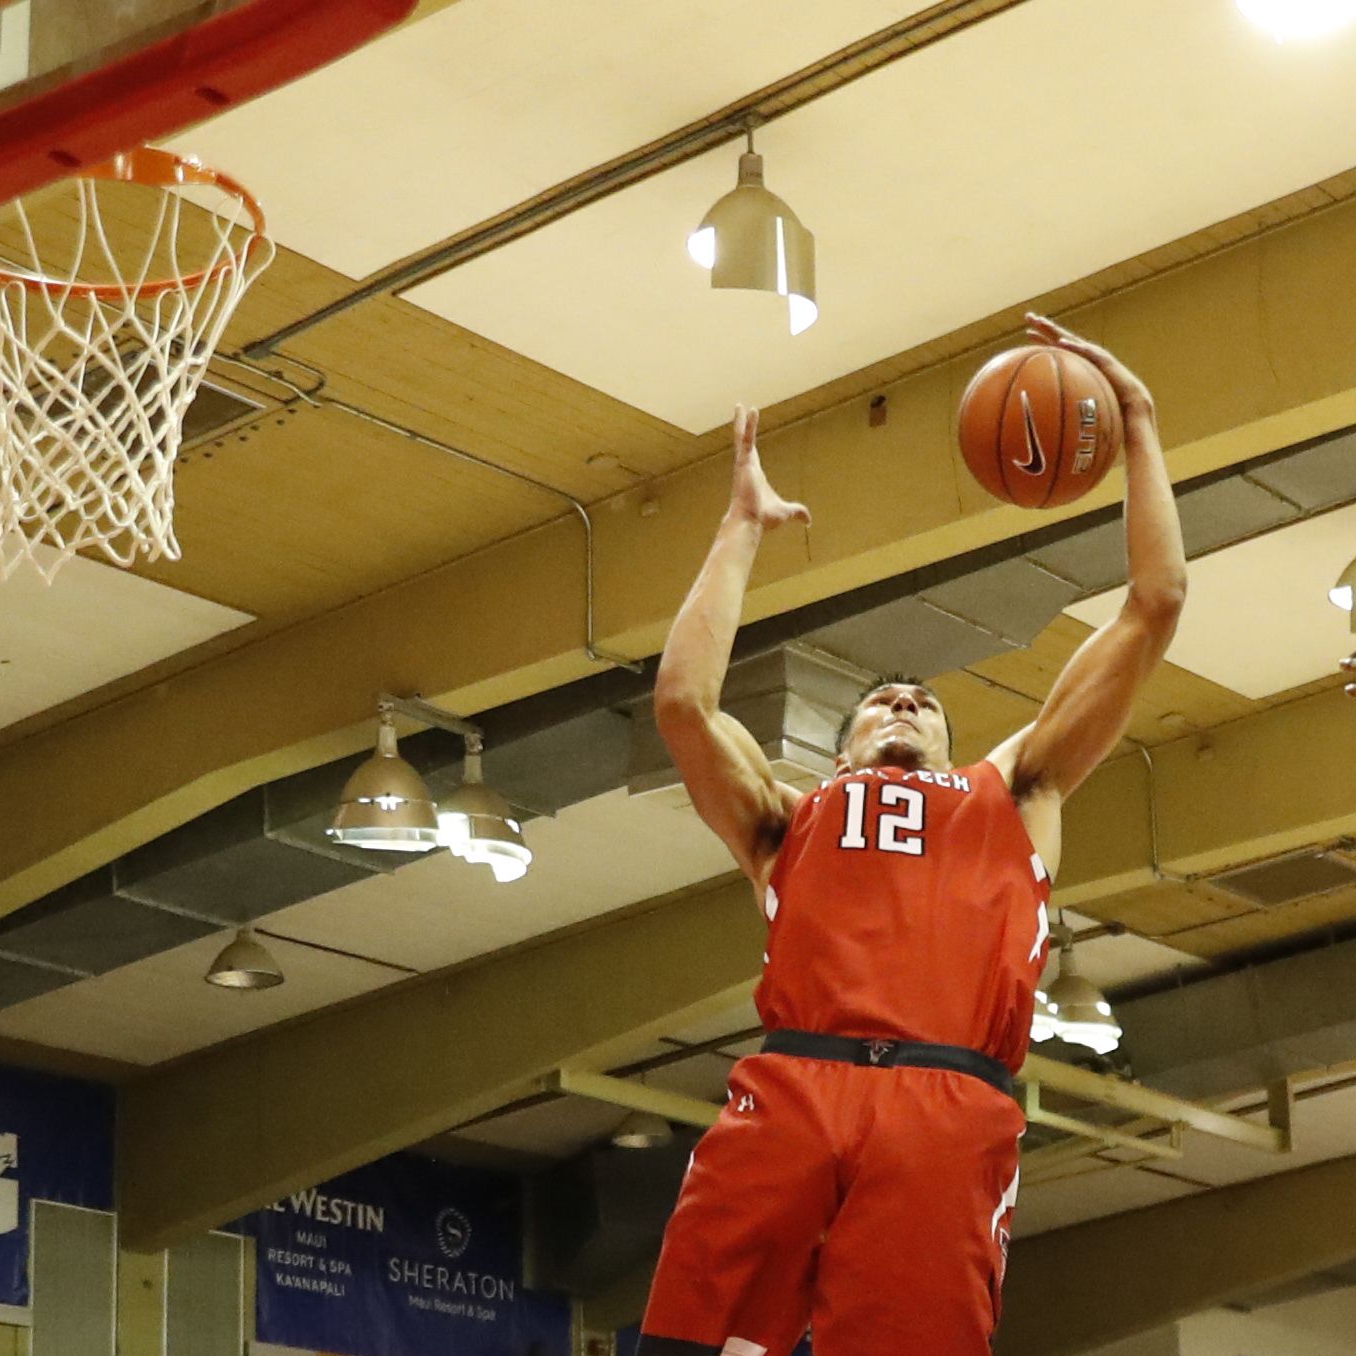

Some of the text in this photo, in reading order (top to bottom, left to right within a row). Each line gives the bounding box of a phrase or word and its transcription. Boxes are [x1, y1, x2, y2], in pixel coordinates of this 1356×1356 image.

[839, 781, 926, 856] 12
[291, 1187, 385, 1233] WESTIN
[297, 1230, 327, 1249] MAUI
[267, 1248, 353, 1277] RESORT & SPA
[389, 1256, 515, 1301] SHERATON
